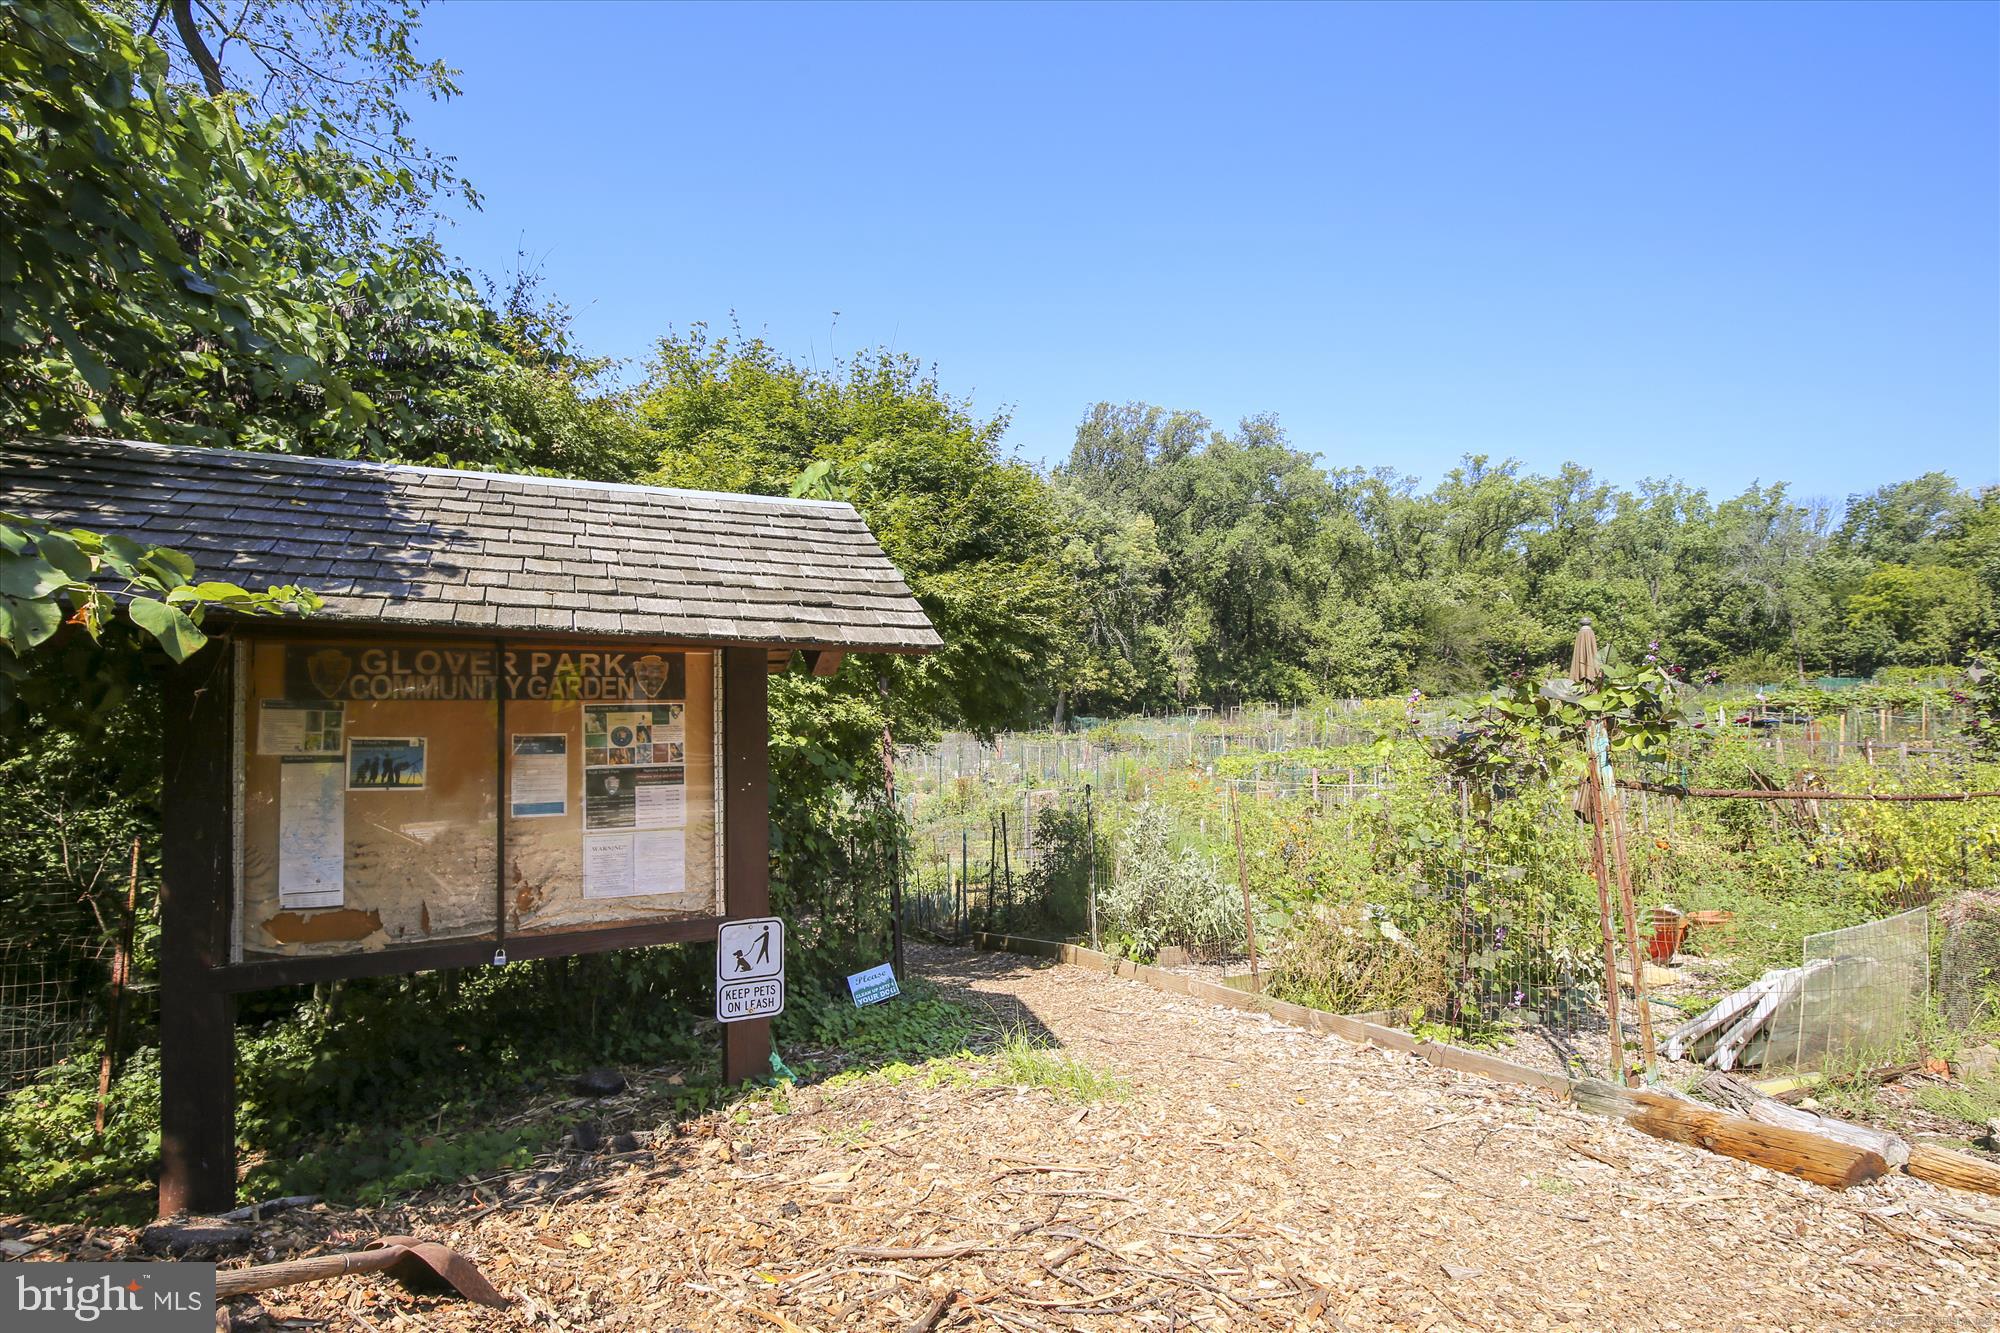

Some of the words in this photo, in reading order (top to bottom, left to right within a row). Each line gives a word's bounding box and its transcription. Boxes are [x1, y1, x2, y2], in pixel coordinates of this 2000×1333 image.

[361, 649, 518, 676] GLOVER
[531, 653, 626, 677] PARK
[351, 674, 523, 699] COMMUNITY
[527, 676, 634, 699] GARDEN
[855, 970, 886, 986] Please
[725, 988, 750, 1001] KEEP
[754, 984, 776, 997] PETS
[856, 989, 871, 999] CLEAN
[858, 993, 879, 1005] YOUR
[880, 986, 897, 997] DOG
[727, 1002, 741, 1013] ON
[745, 997, 775, 1011] LEASH
